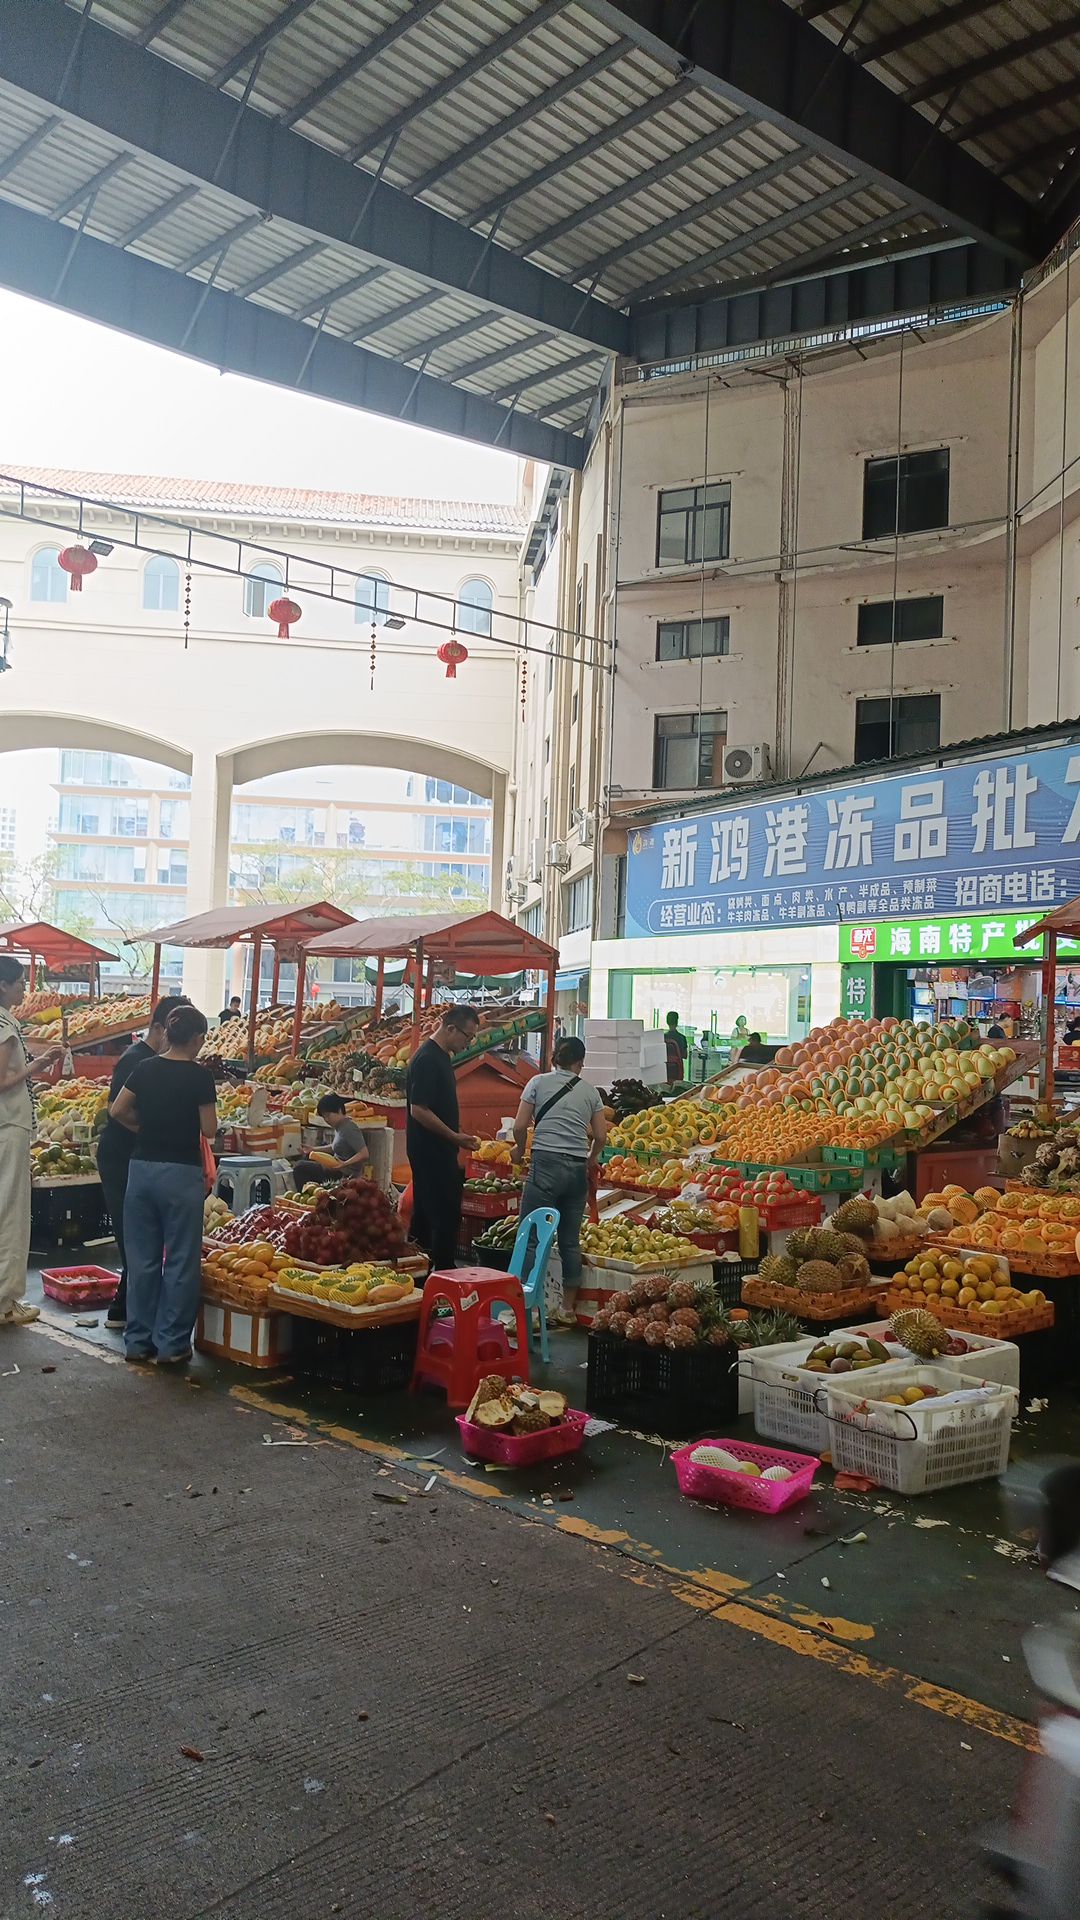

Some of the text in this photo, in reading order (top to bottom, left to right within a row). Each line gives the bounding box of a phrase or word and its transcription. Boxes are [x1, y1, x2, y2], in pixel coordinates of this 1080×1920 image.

[955, 869, 1067, 906] 招商电话：
[660, 901, 722, 928] 经营业态：
